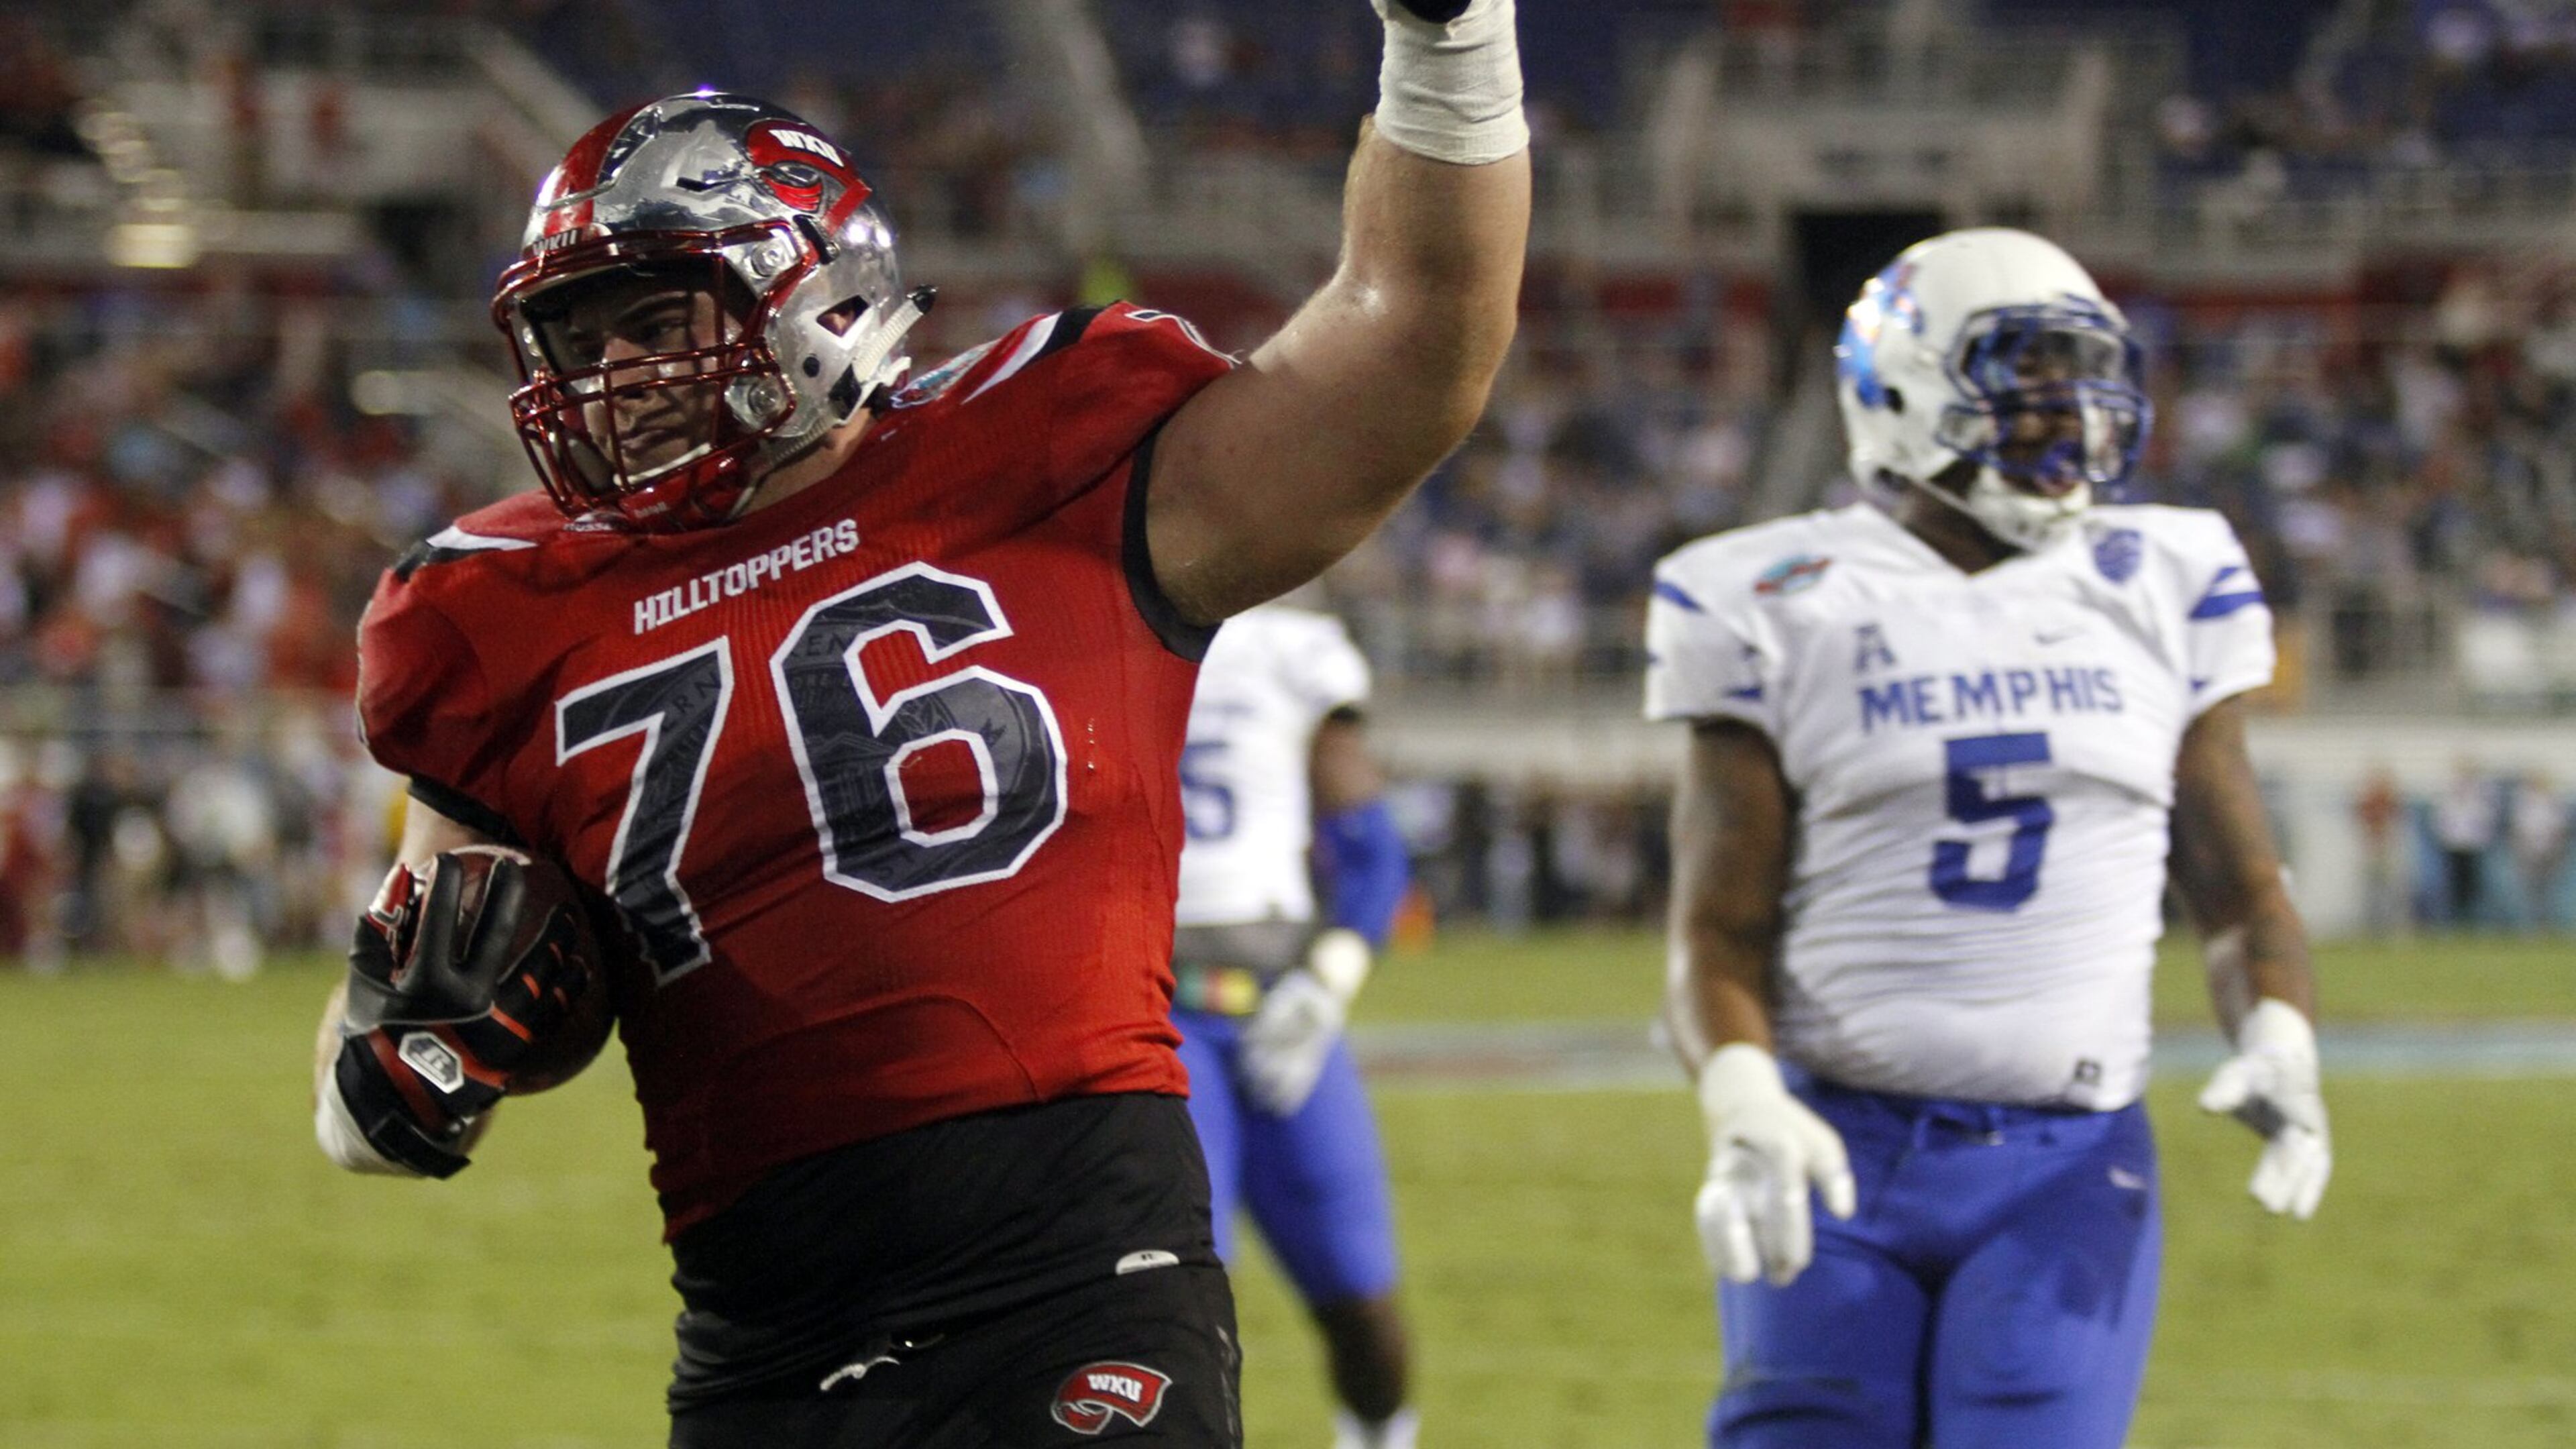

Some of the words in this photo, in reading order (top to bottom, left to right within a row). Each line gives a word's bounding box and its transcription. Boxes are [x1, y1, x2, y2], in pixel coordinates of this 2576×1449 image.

[769, 129, 845, 168] WKU
[633, 519, 859, 634] HILLTOPPERS
[1856, 666, 2125, 735] MEMPHIS
[555, 561, 1067, 986] 76
[1929, 732, 2055, 913] 5
[1087, 1375, 1142, 1403] WKU
